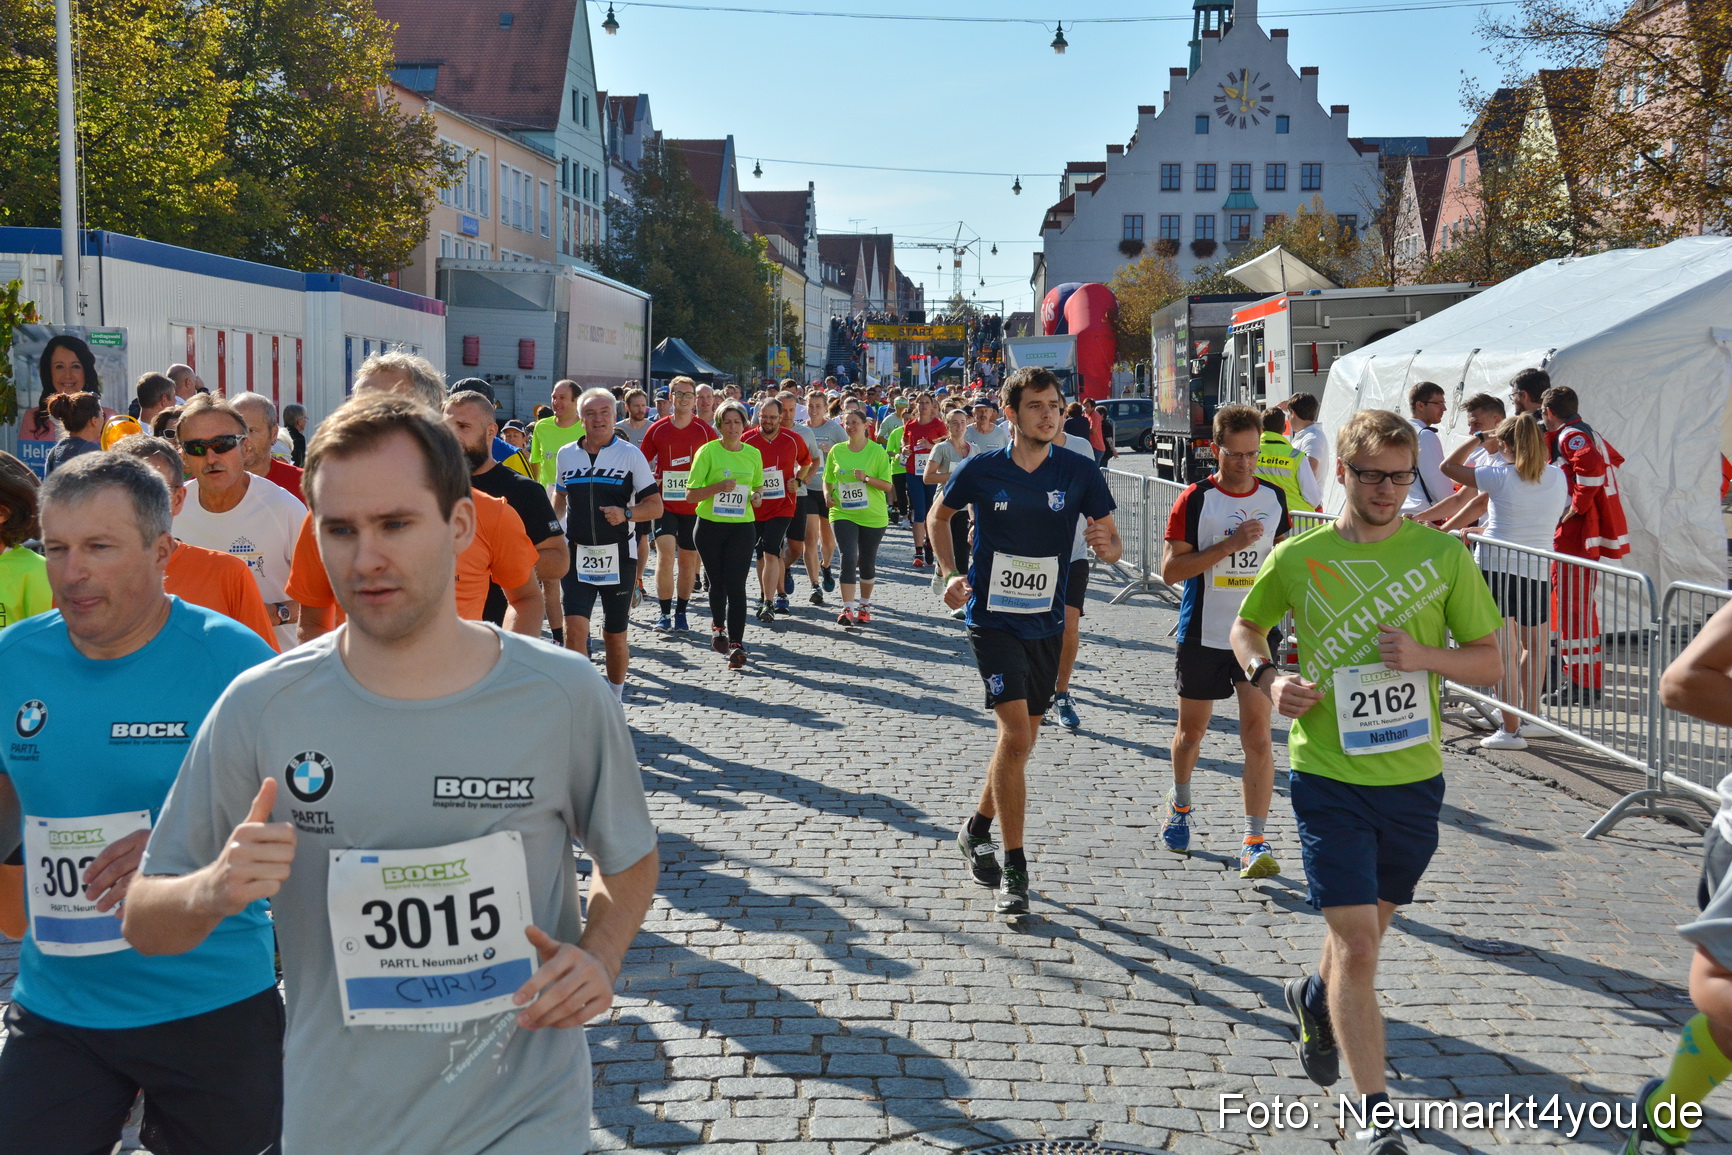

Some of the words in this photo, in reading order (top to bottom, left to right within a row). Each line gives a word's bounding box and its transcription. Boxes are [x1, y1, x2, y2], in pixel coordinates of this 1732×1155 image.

[899, 328, 934, 337] START
[719, 492, 743, 504] 2170
[842, 489, 863, 499] 2165
[994, 502, 1008, 511] PM
[582, 556, 612, 568] 2317
[1012, 560, 1041, 569] BOCK
[1000, 570, 1048, 590] 3040
[1306, 558, 1440, 683] BURKHARDT
[1350, 644, 1372, 664] UND
[1370, 583, 1450, 646] GUDETECHNIK
[1350, 682, 1417, 718] 2162
[1360, 720, 1380, 728] PARTL
[1381, 715, 1407, 724] Neumarkt
[110, 722, 189, 738] BOCK
[1370, 728, 1408, 744] Nathan
[11, 743, 40, 754] PARTL
[290, 752, 332, 770] BMW
[434, 776, 535, 800] BOCK
[432, 800, 466, 809] inspired
[468, 801, 478, 810] by
[291, 808, 334, 824] PARTL
[48, 828, 106, 845] BOCK
[382, 858, 470, 884] BOCK
[50, 904, 72, 912] PARTL
[361, 886, 501, 950] 3015
[346, 942, 354, 950] C
[380, 959, 420, 968] PARTL
[422, 954, 479, 968] Neumarkt
[396, 968, 497, 1003] CHRIS
[456, 1031, 497, 1073] September
